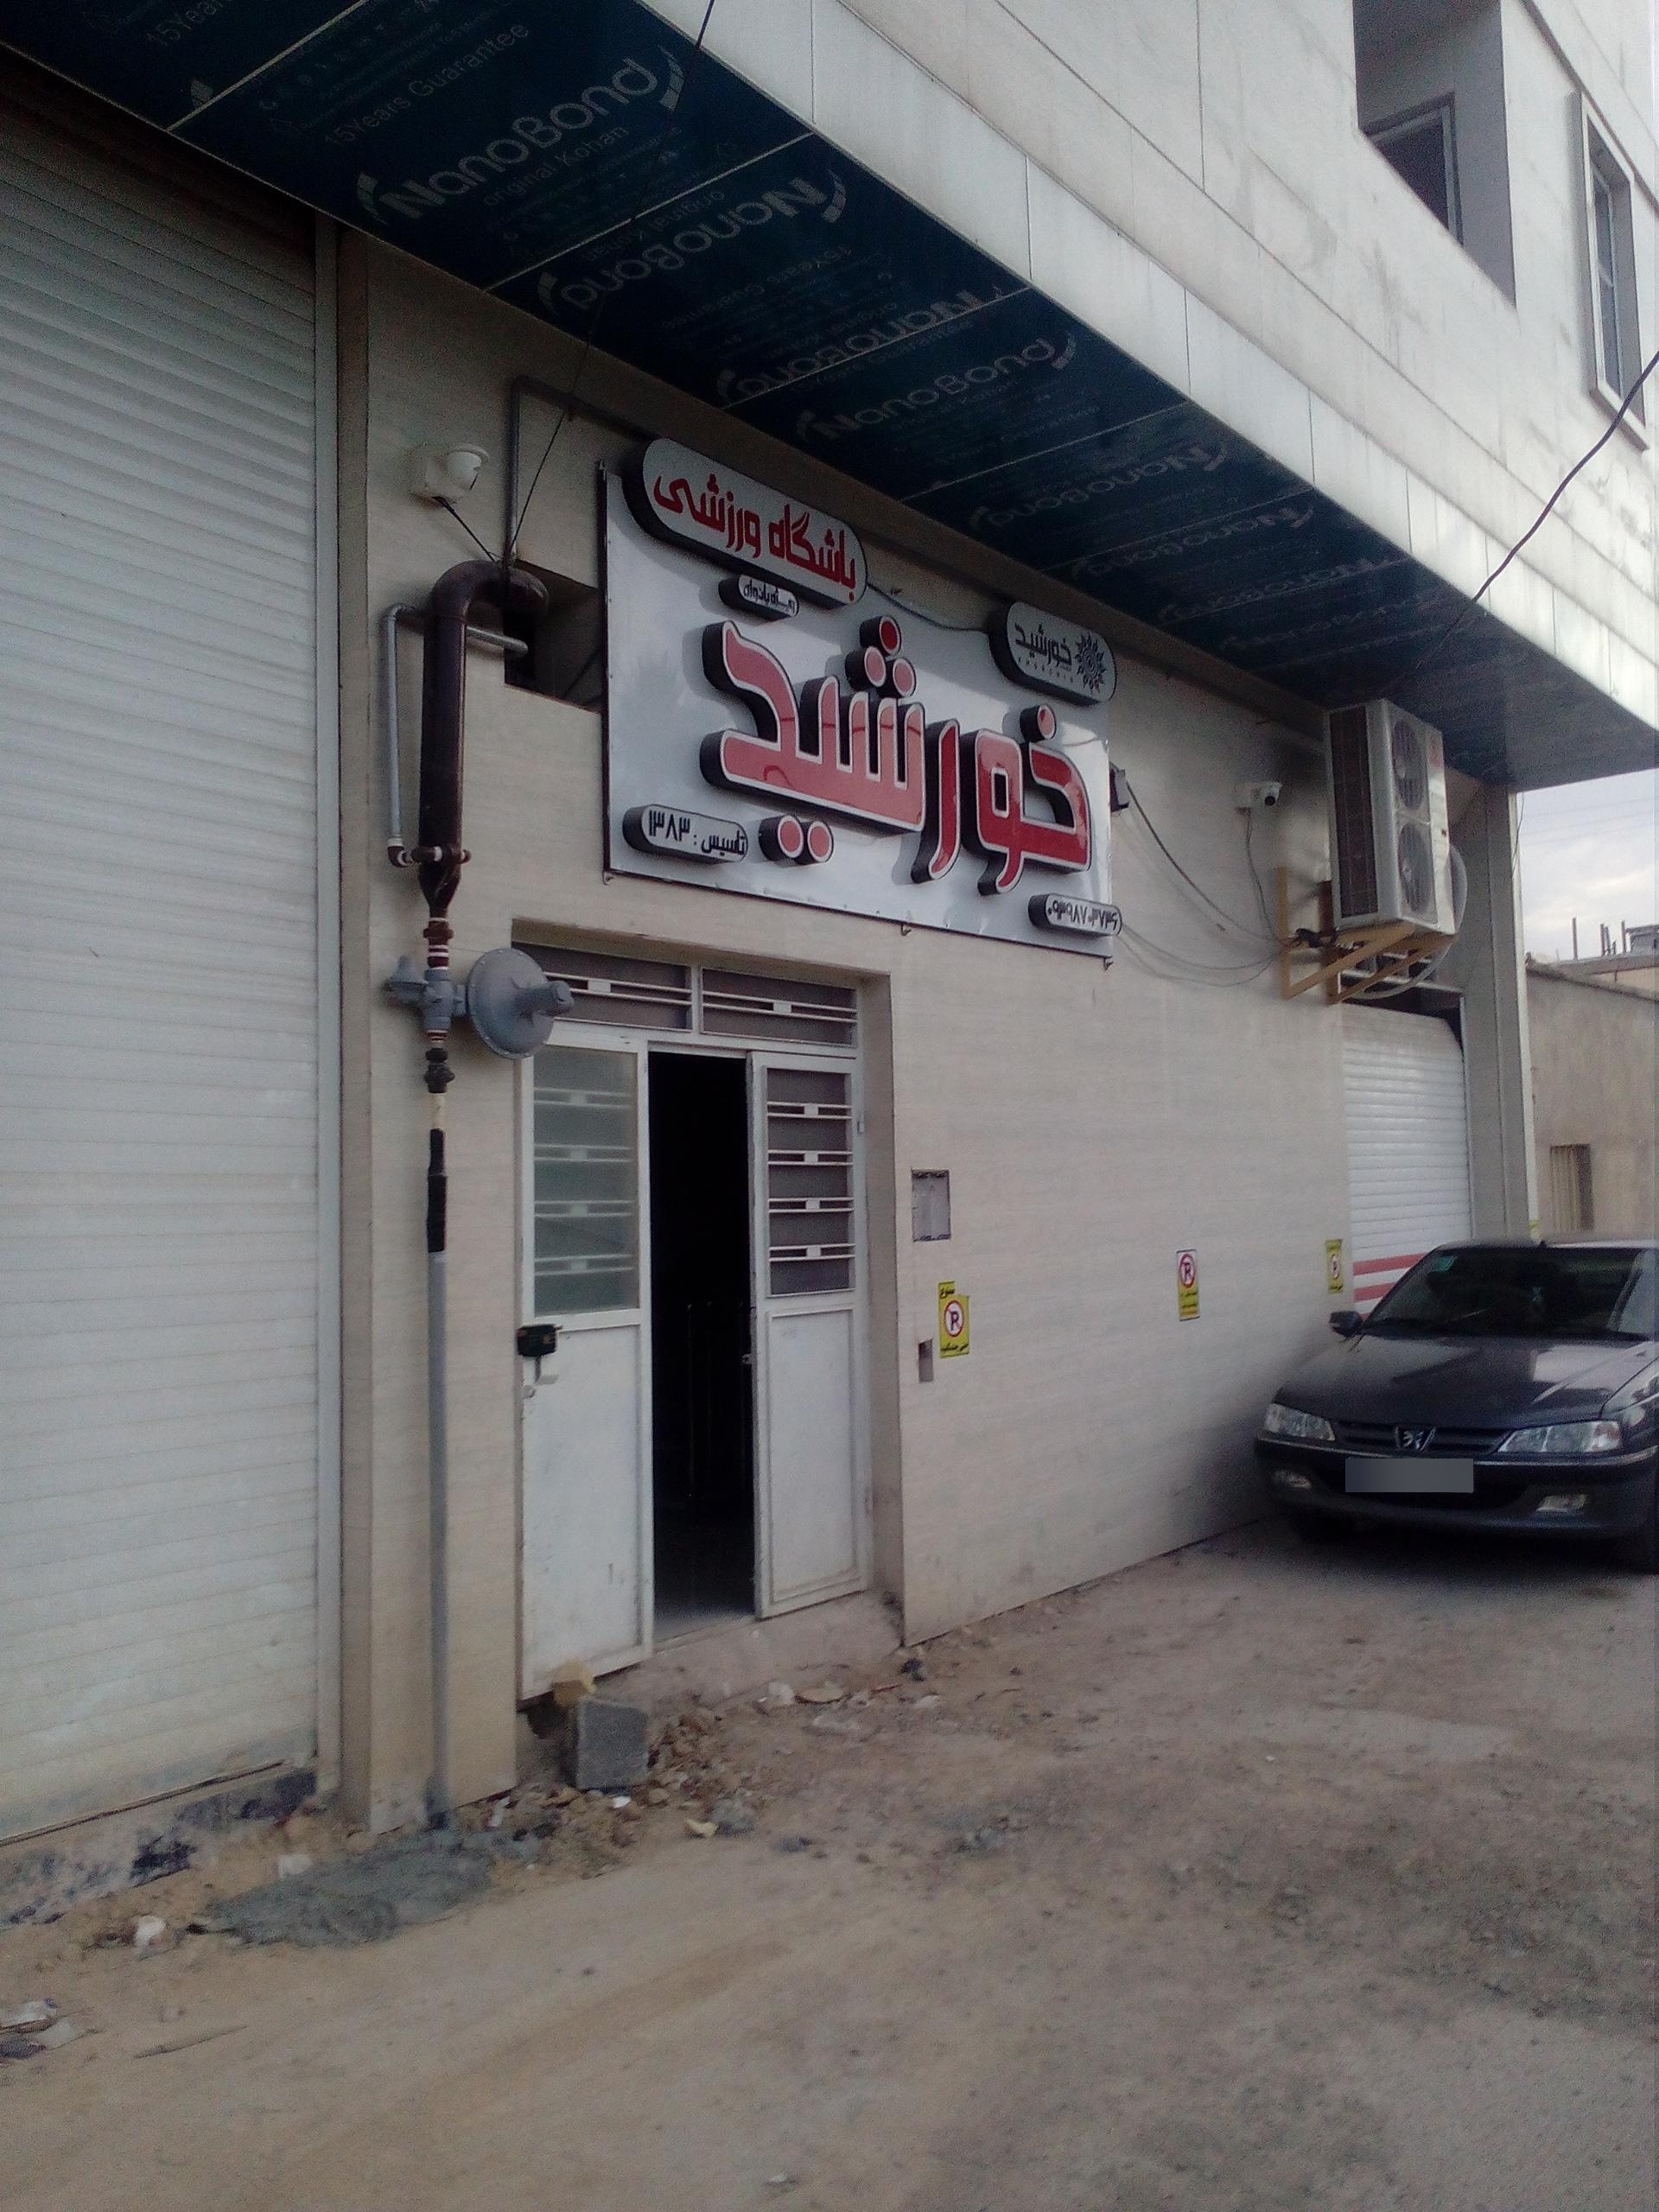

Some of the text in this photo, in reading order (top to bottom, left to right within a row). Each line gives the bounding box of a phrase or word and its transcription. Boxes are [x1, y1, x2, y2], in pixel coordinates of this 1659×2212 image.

[408, 22, 529, 97] Guarantee
[379, 57, 657, 219] NanoBond
[560, 177, 827, 310] NanoBond
[811, 338, 1055, 439] NanoBond
[653, 474, 856, 601] باشگاه ورزشی
[1014, 622, 1071, 667] خورشید
[719, 615, 1092, 895] خورشید
[648, 810, 690, 842] ۱۳۸۳
